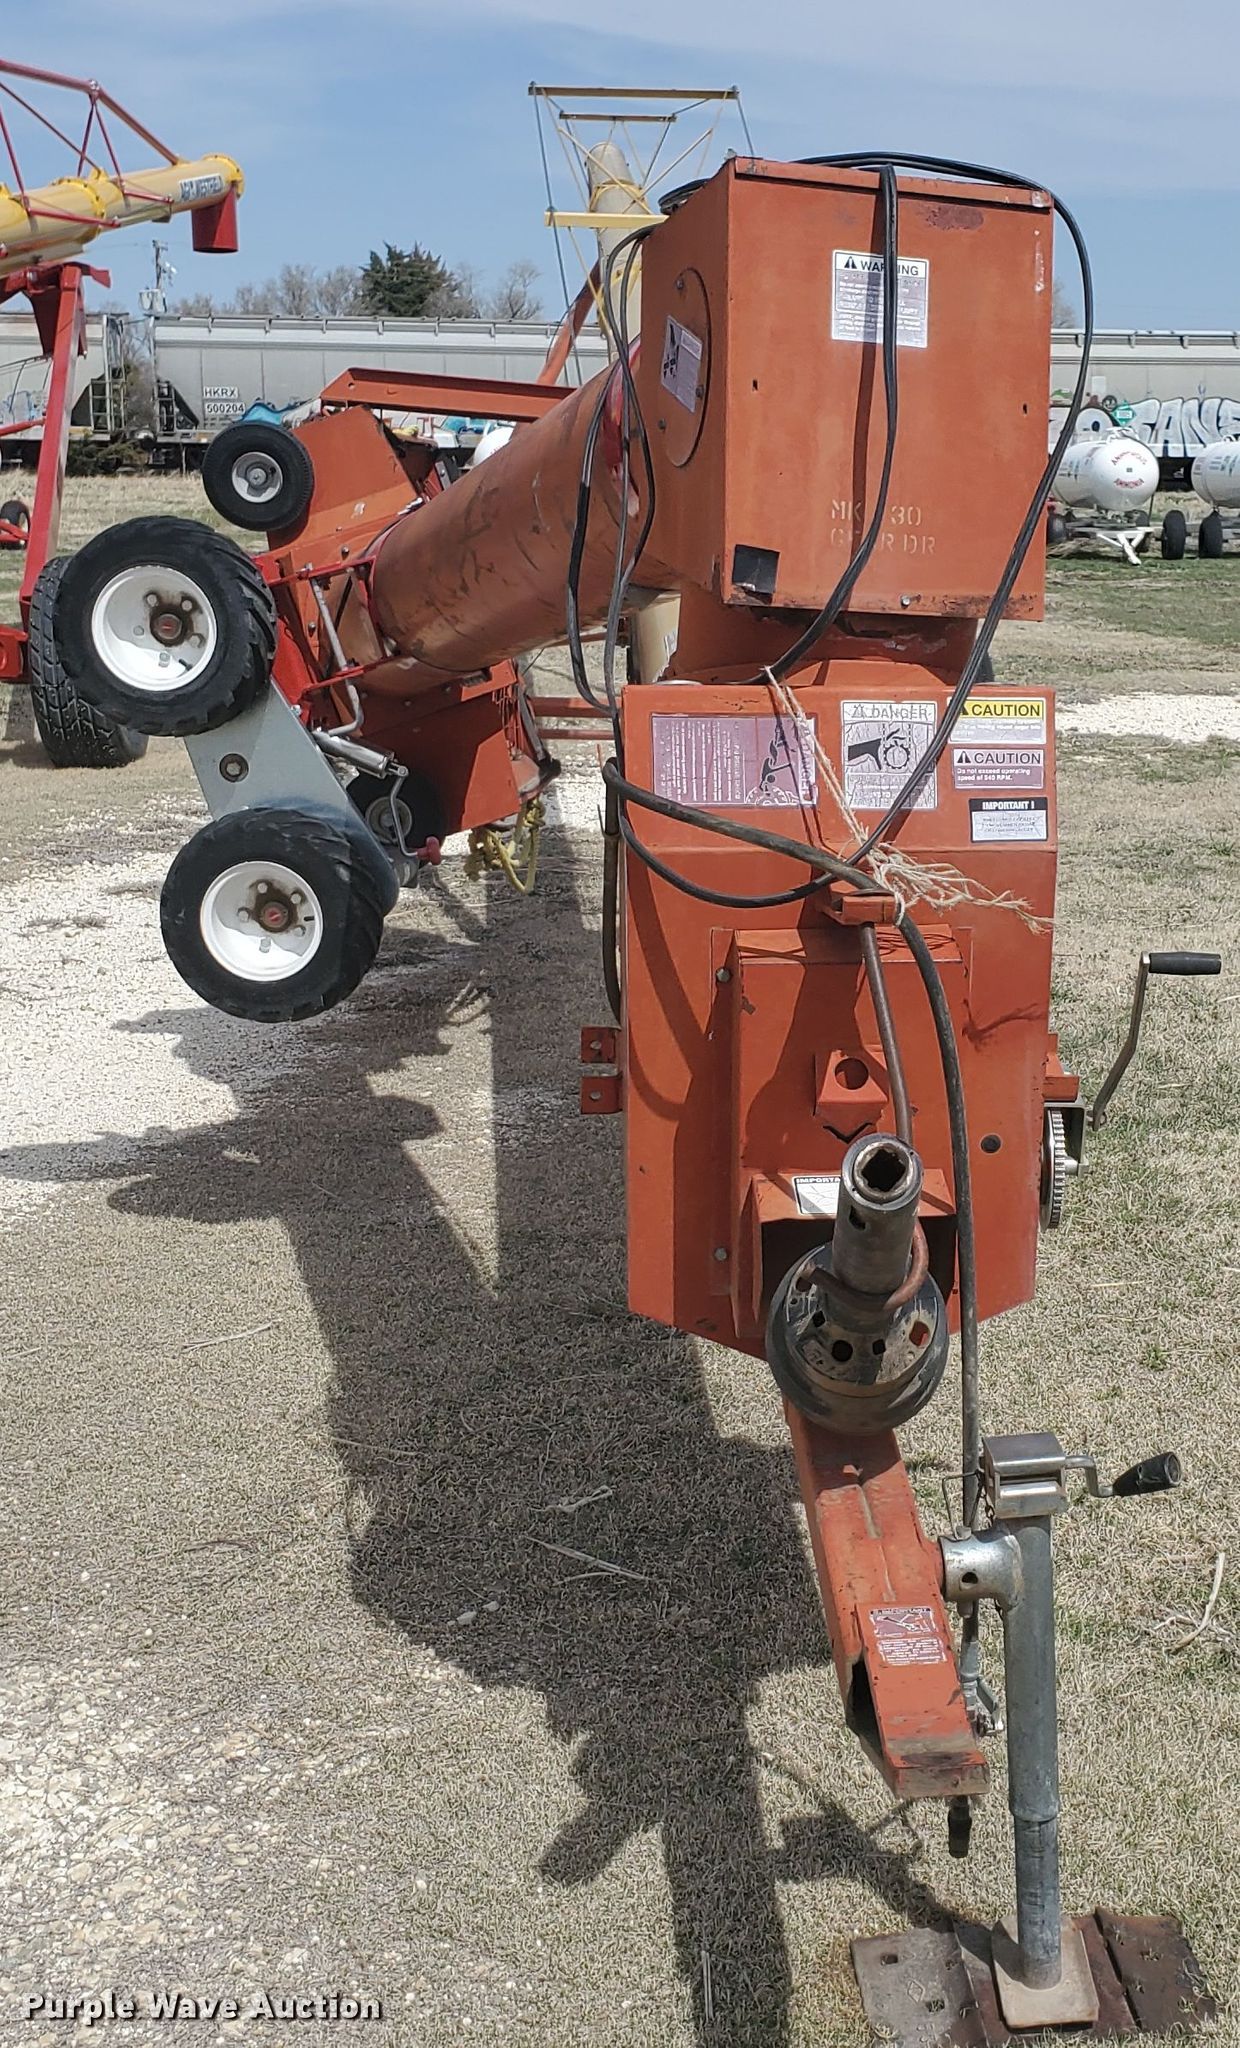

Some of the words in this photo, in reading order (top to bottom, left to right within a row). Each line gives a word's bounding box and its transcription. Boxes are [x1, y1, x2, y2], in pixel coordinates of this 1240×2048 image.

[205, 387, 235, 397] HKRX
[207, 403, 244, 413] 500204
[831, 499, 862, 521] MK
[872, 706, 928, 719] DANGER
[971, 704, 1040, 717] CAUTION
[974, 752, 1041, 764] CAUTION
[1001, 768, 1031, 776] operating
[957, 774, 976, 782] speed
[982, 801, 1029, 810] IMPORTANT
